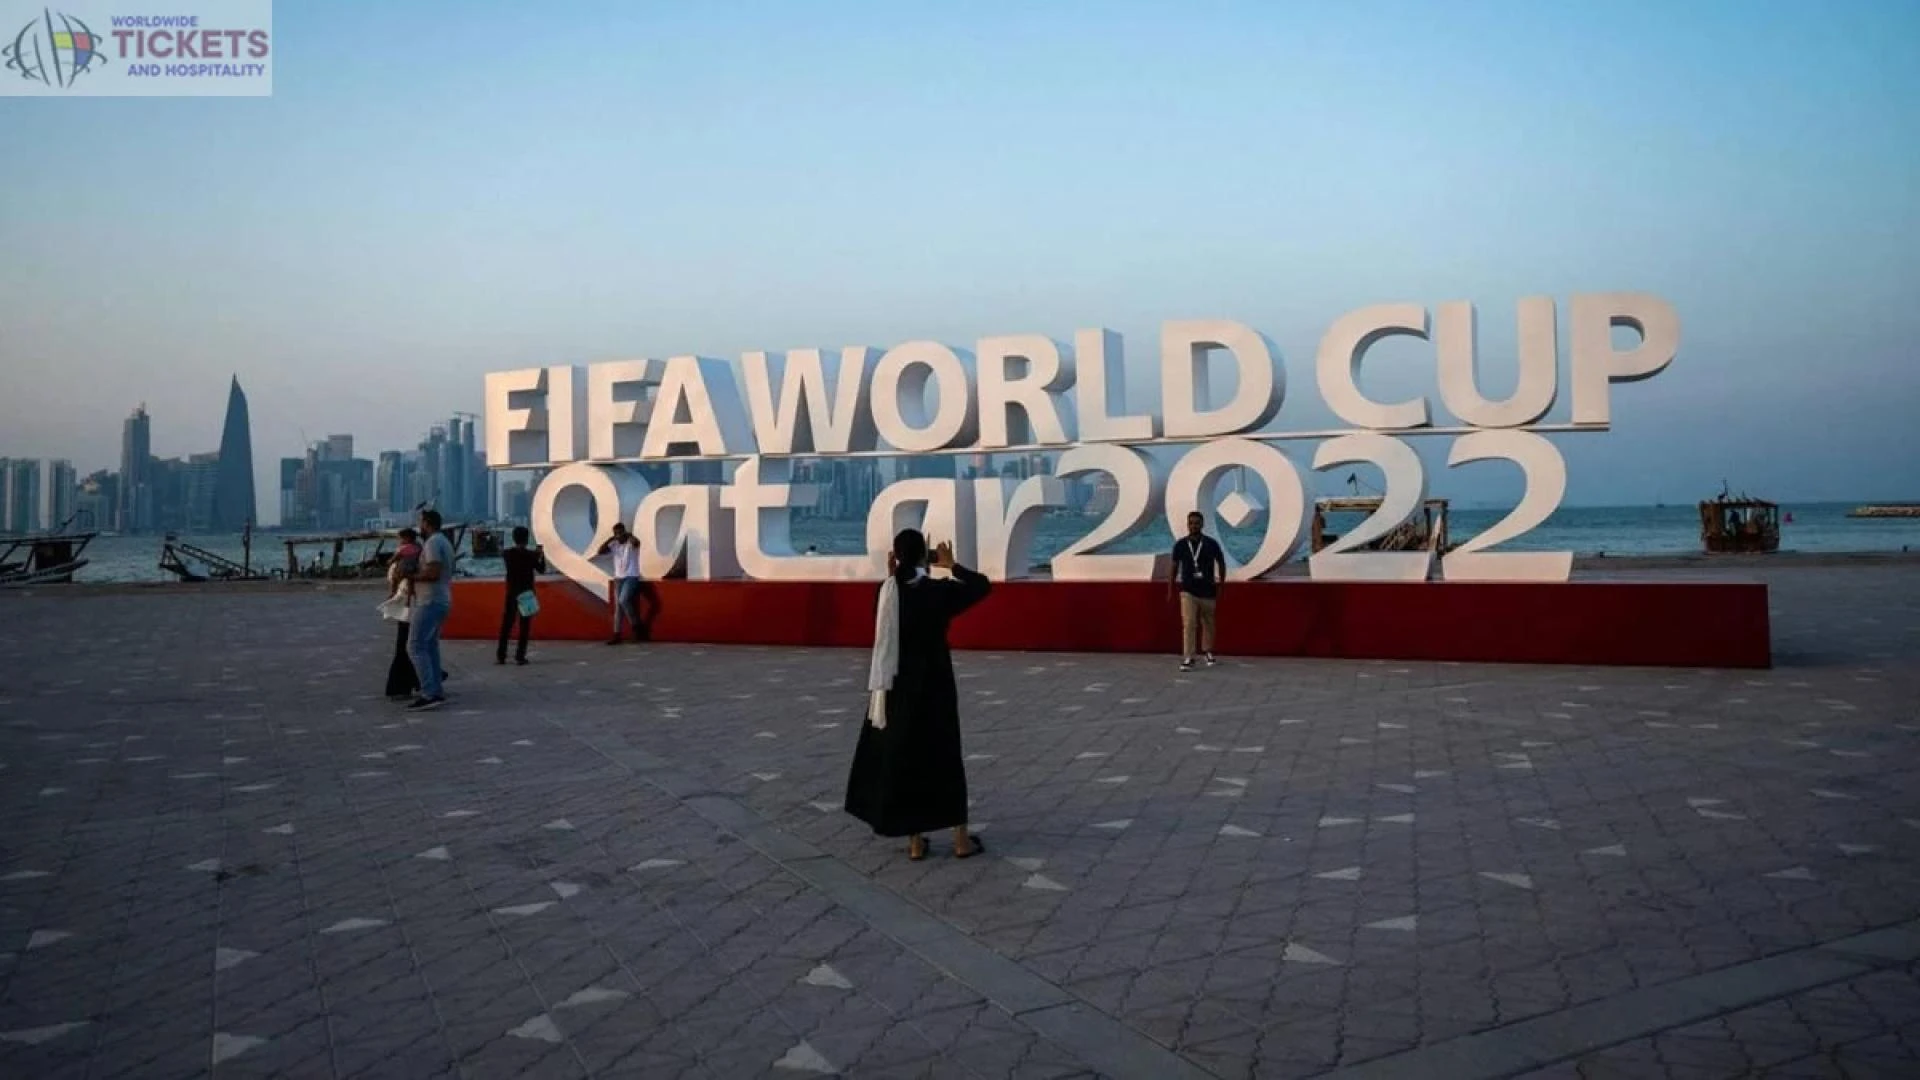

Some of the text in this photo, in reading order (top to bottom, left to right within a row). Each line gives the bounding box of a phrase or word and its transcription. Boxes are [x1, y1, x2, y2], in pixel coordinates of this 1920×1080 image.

[485, 291, 1681, 466] FIFA WORLD CUP
[531, 429, 1574, 603] Qatar 2022
